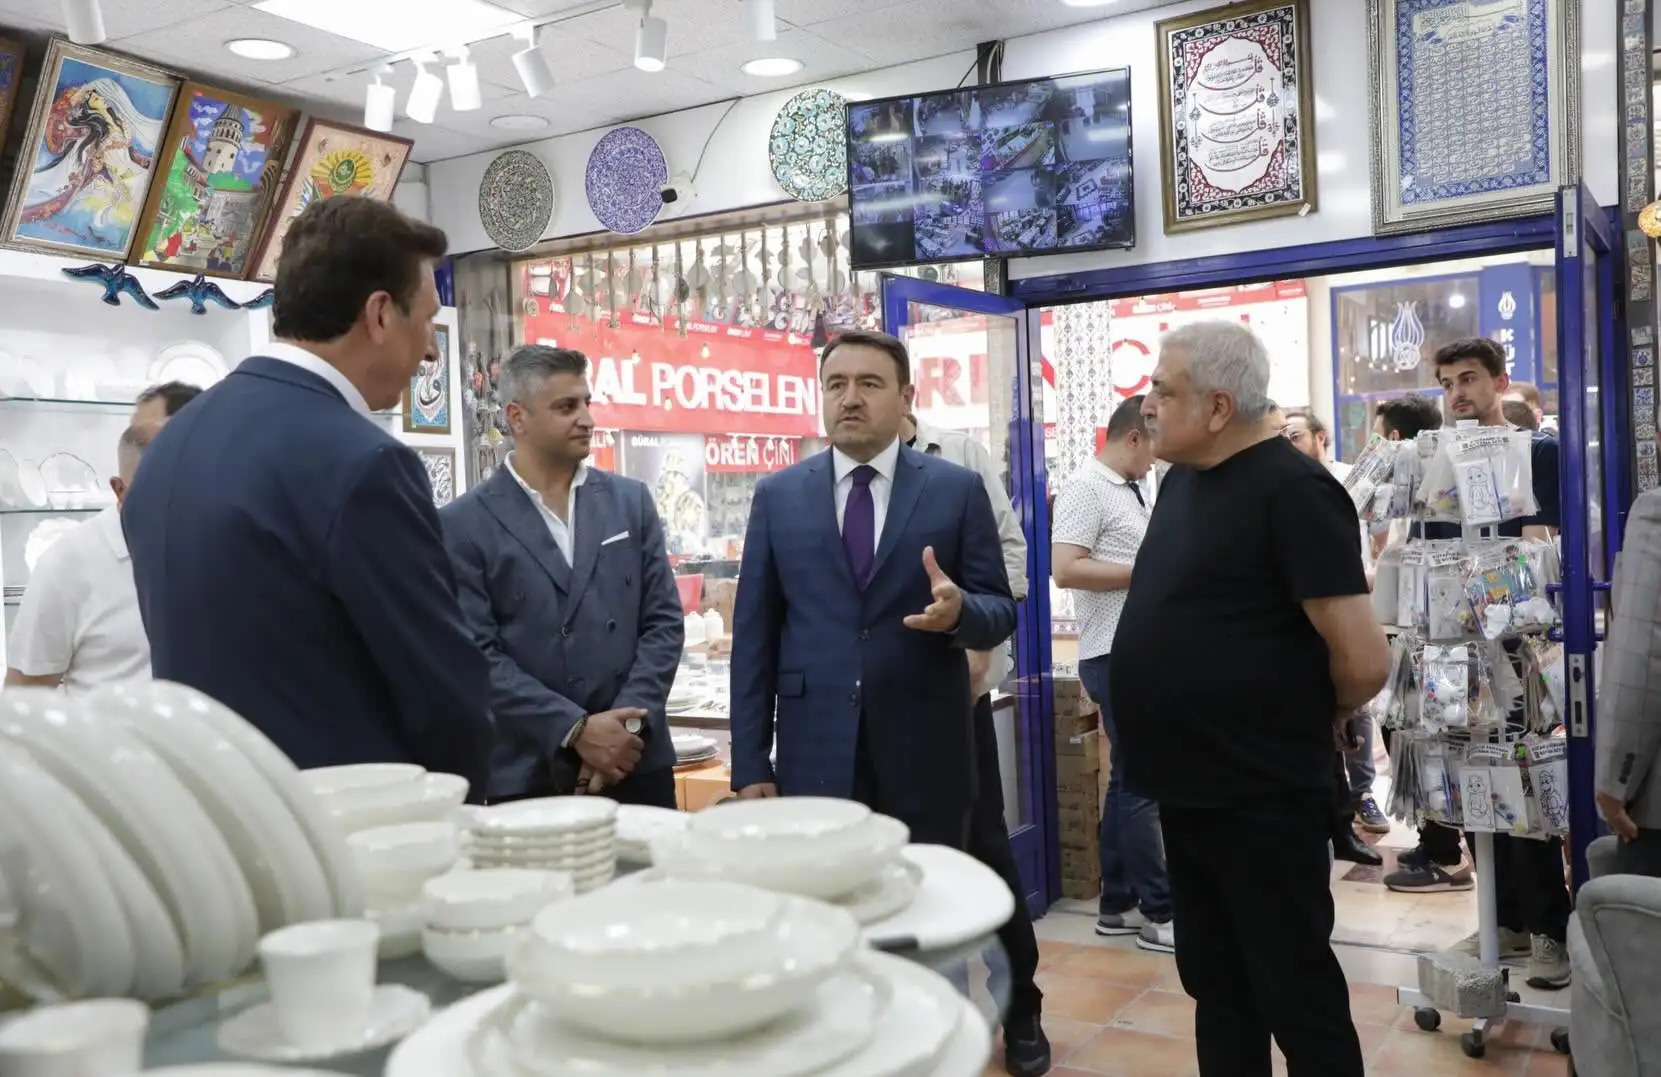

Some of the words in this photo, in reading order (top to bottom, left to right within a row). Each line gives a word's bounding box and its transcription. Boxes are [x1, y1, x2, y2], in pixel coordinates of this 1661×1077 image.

[586, 356, 647, 406] AL
[651, 361, 816, 416] PORSELEN
[705, 438, 759, 466] ÖREN
